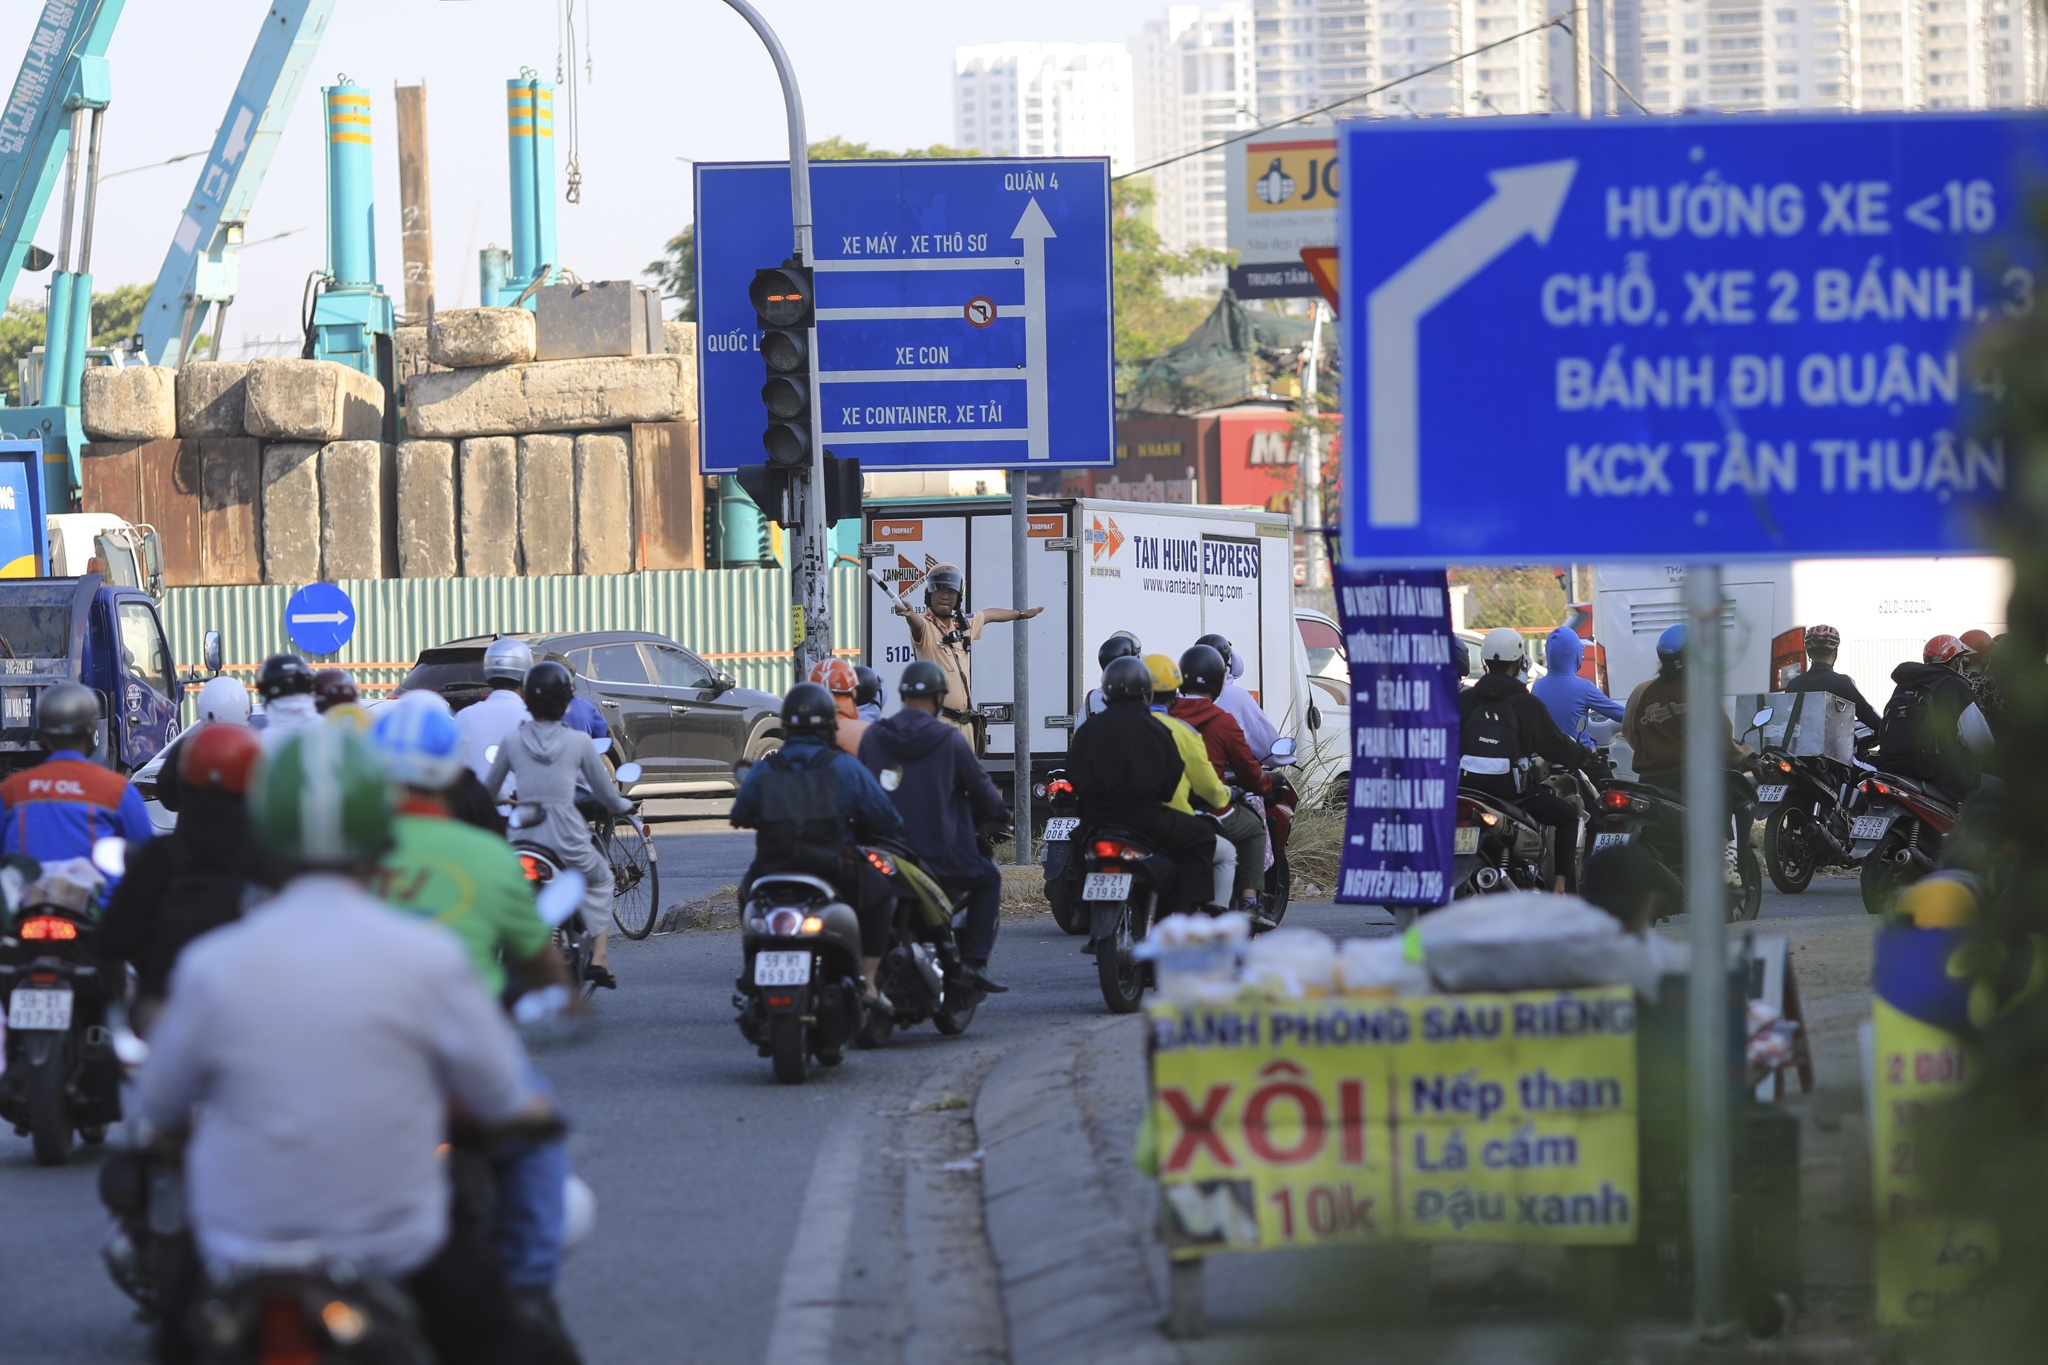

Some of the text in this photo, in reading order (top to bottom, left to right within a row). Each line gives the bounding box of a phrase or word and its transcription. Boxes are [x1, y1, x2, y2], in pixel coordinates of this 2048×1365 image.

[8, 68, 42, 118] TNHH
[27, 26, 57, 70] LÂM
[20, 106, 37, 134] 0903
[30, 83, 46, 106] 719
[38, 65, 54, 85] 511
[49, 29, 67, 57] 0909
[1004, 170, 1059, 194] QUẬN 4
[1605, 169, 1996, 240] HƯỚNG XE <16
[842, 236, 861, 254] XE
[866, 231, 898, 254] MÁY
[911, 235, 930, 253] XE
[933, 231, 963, 253] THÔ
[967, 233, 988, 252] SƠ
[1683, 270, 1755, 325] XE
[1766, 270, 1800, 323] 2
[707, 328, 766, 353] QUỐC L
[895, 346, 949, 365] XE CON
[1556, 342, 1715, 411] BÁNH
[1727, 354, 1784, 408] ĐI
[1798, 342, 1959, 416] QUẬN
[841, 399, 1002, 426] XE CONTAINER, XE TẢI
[1566, 429, 2005, 502] KCX TÂN THUẬN
[1163, 538, 1198, 573] HUNG
[1204, 542, 1259, 579] EXPRESS
[1142, 576, 1243, 603] www.vantaitanhung.com
[1411, 628, 1451, 672] THUẬN
[1408, 728, 1448, 765] NGHỊ
[28, 779, 86, 796] PV OIL
[1413, 778, 1446, 810] LINH
[1045, 830, 1071, 840] 008.2
[1052, 819, 1077, 829] 59-E2
[1086, 887, 1124, 899] 619.82
[1092, 875, 1123, 886] 59-Z1
[1411, 1068, 1622, 1121] Nếp than
[1158, 1059, 1366, 1174] XÔI
[1413, 1130, 1468, 1172] Lá
[1268, 1183, 1379, 1240] 10k
[1411, 1181, 1630, 1234] Đậu xanh
